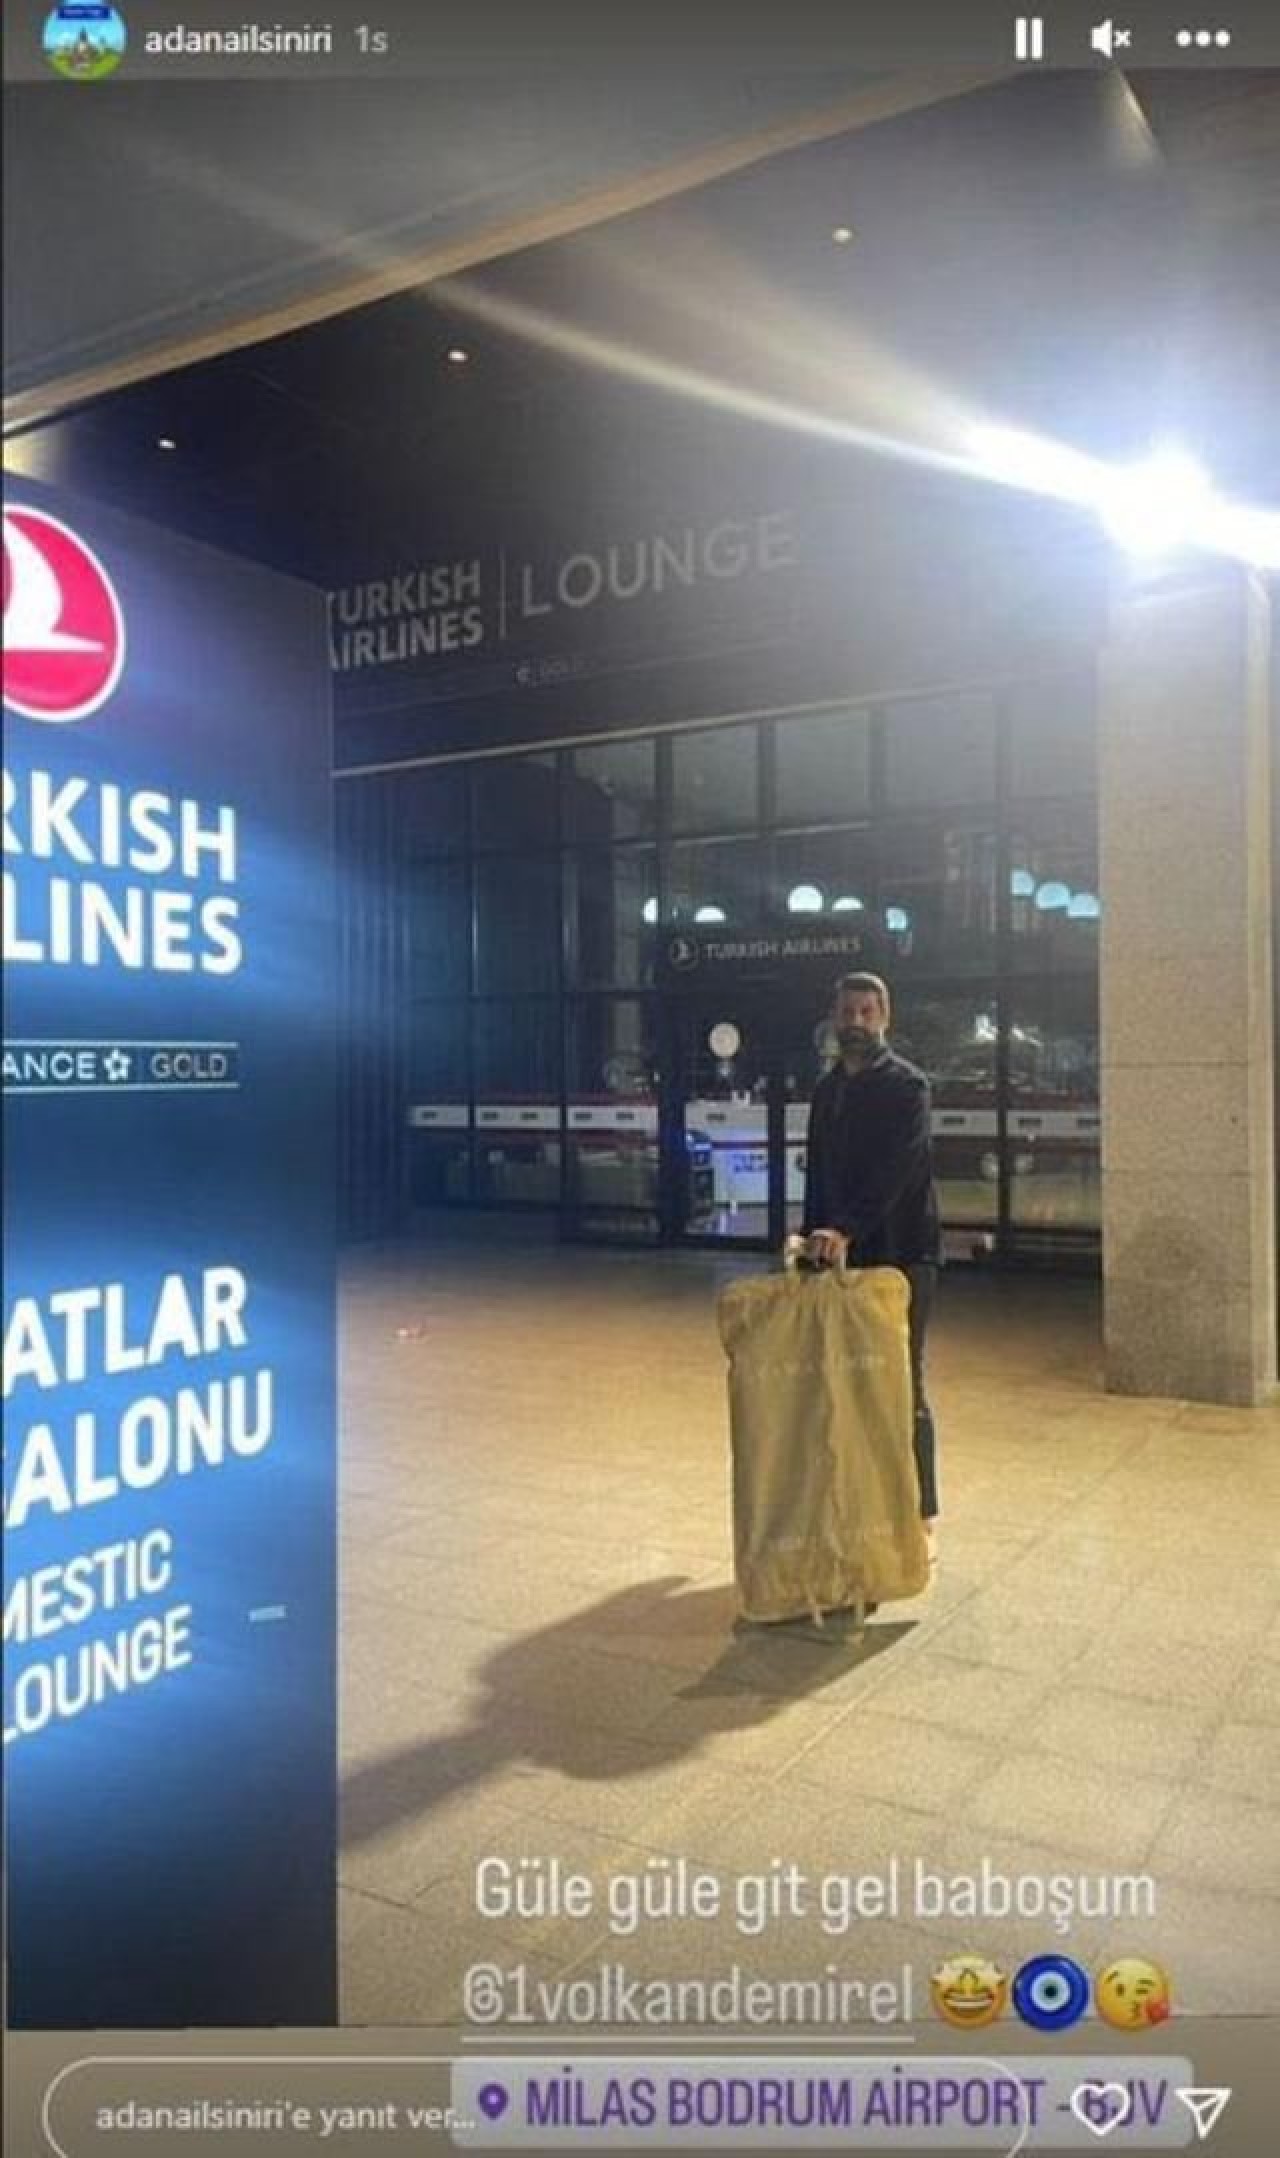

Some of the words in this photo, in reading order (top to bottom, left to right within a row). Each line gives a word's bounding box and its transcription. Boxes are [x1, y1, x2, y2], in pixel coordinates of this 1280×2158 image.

[521, 511, 797, 618] LOUNGE
[151, 1053, 228, 1081] GOLD
[3, 1264, 248, 1397] ATLAR
[3, 1369, 273, 1529] ALONU
